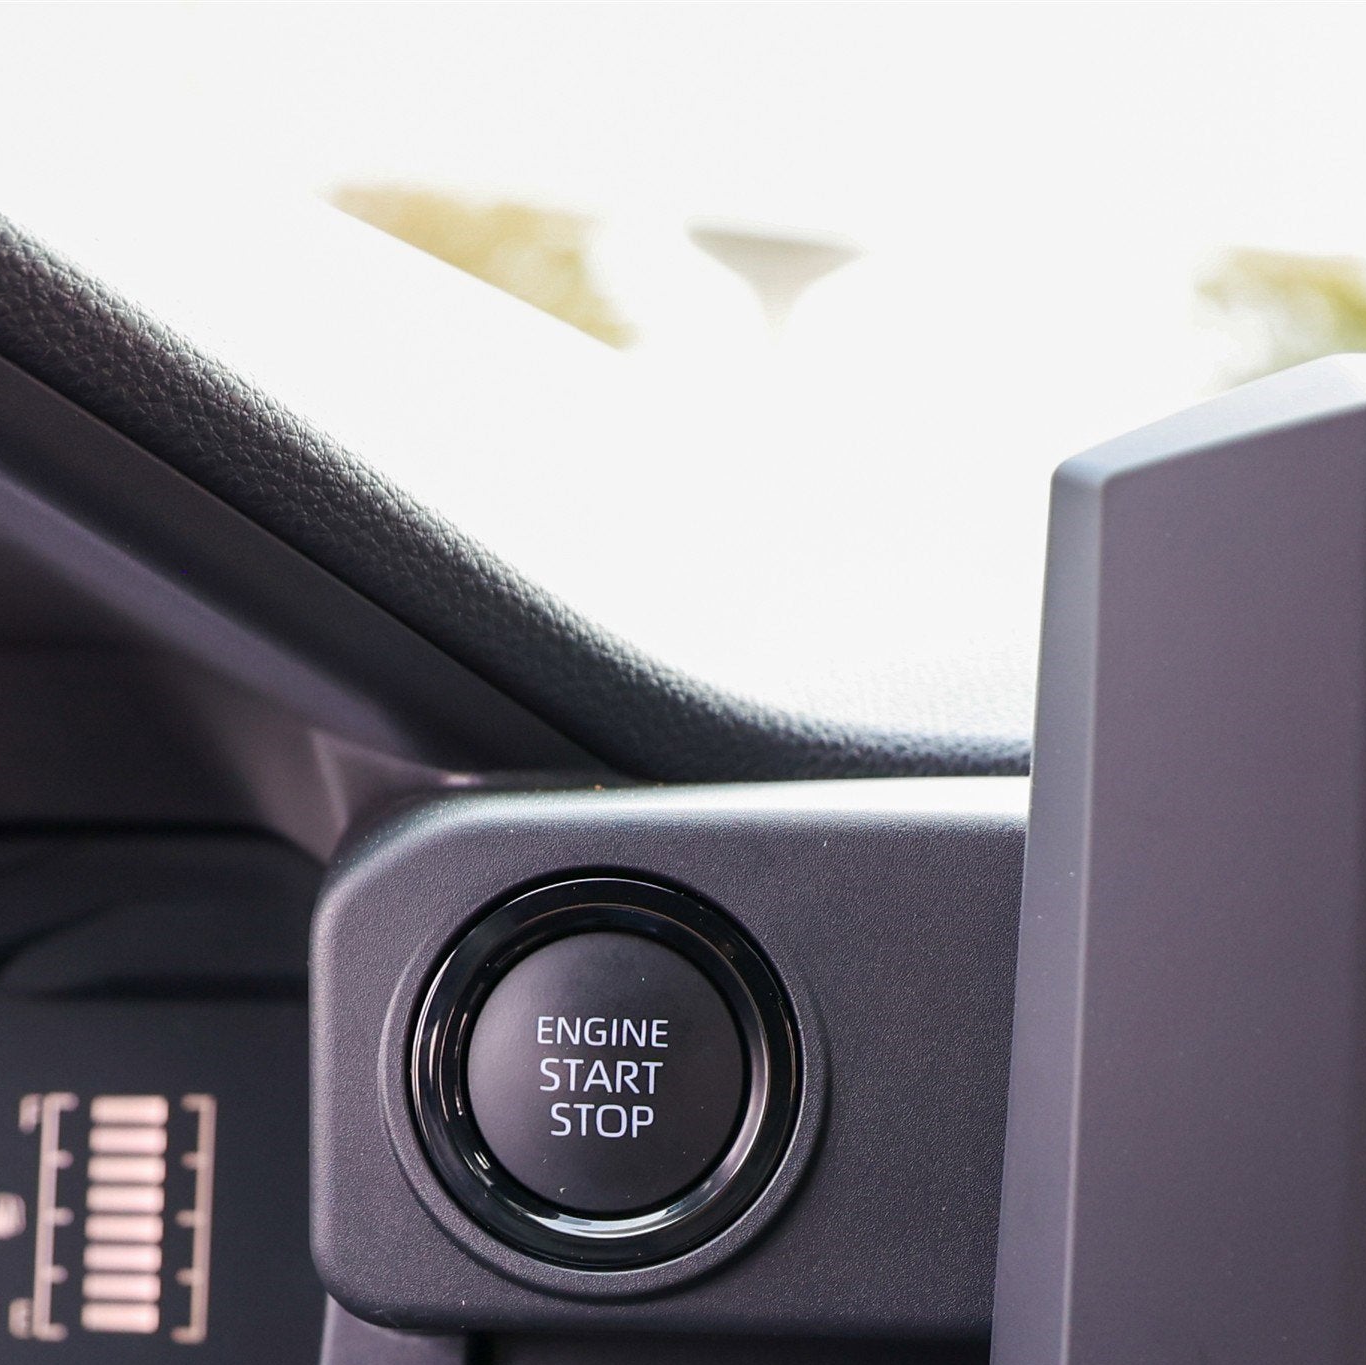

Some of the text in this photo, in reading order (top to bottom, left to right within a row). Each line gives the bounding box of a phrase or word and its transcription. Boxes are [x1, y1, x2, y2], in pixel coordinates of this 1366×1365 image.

[537, 1017, 668, 1047] ENGINE
[540, 1058, 663, 1095] START
[550, 1103, 654, 1138] STOP
